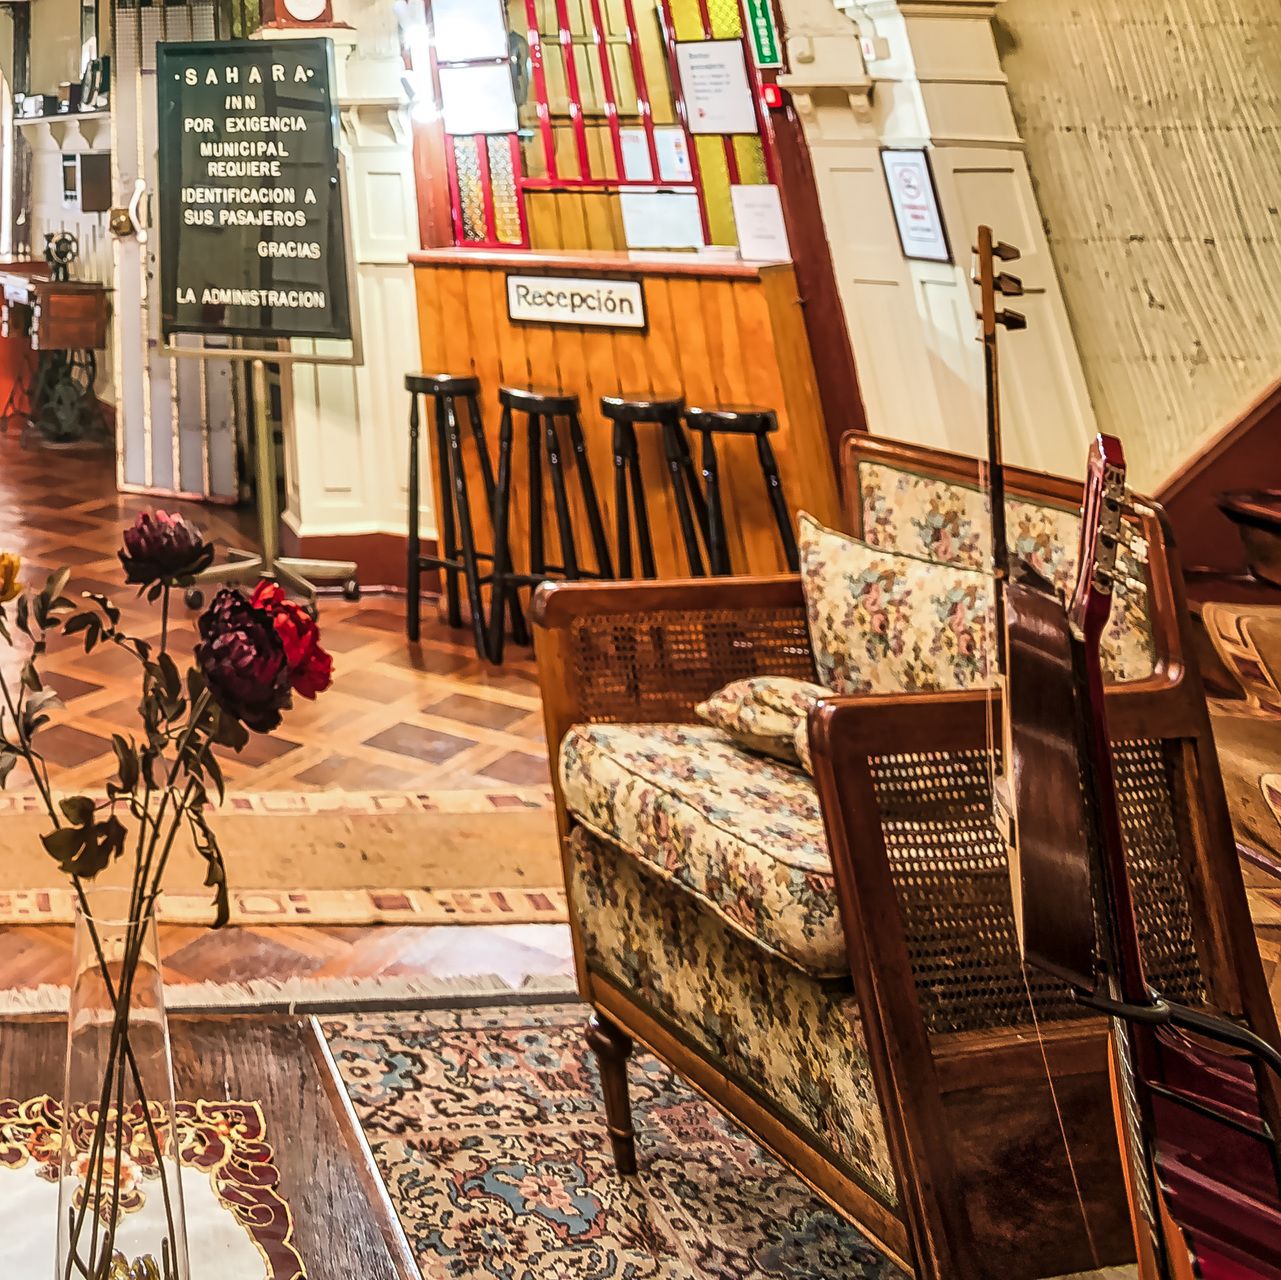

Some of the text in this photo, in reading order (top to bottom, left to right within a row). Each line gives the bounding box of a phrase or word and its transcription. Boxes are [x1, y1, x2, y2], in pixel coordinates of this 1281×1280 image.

[225, 95, 256, 110] INN
[184, 116, 307, 133] POR EXIGENCIA
[200, 141, 289, 157] MUNICIPAL
[207, 161, 282, 177] REQUIERE
[181, 187, 317, 204] IDENTIFICACION A
[183, 209, 307, 227] SUS PASAJEROS
[257, 241, 321, 259] GRACIAS
[176, 287, 326, 308] LA ADMINISTRACION
[516, 284, 635, 315] Recepción
